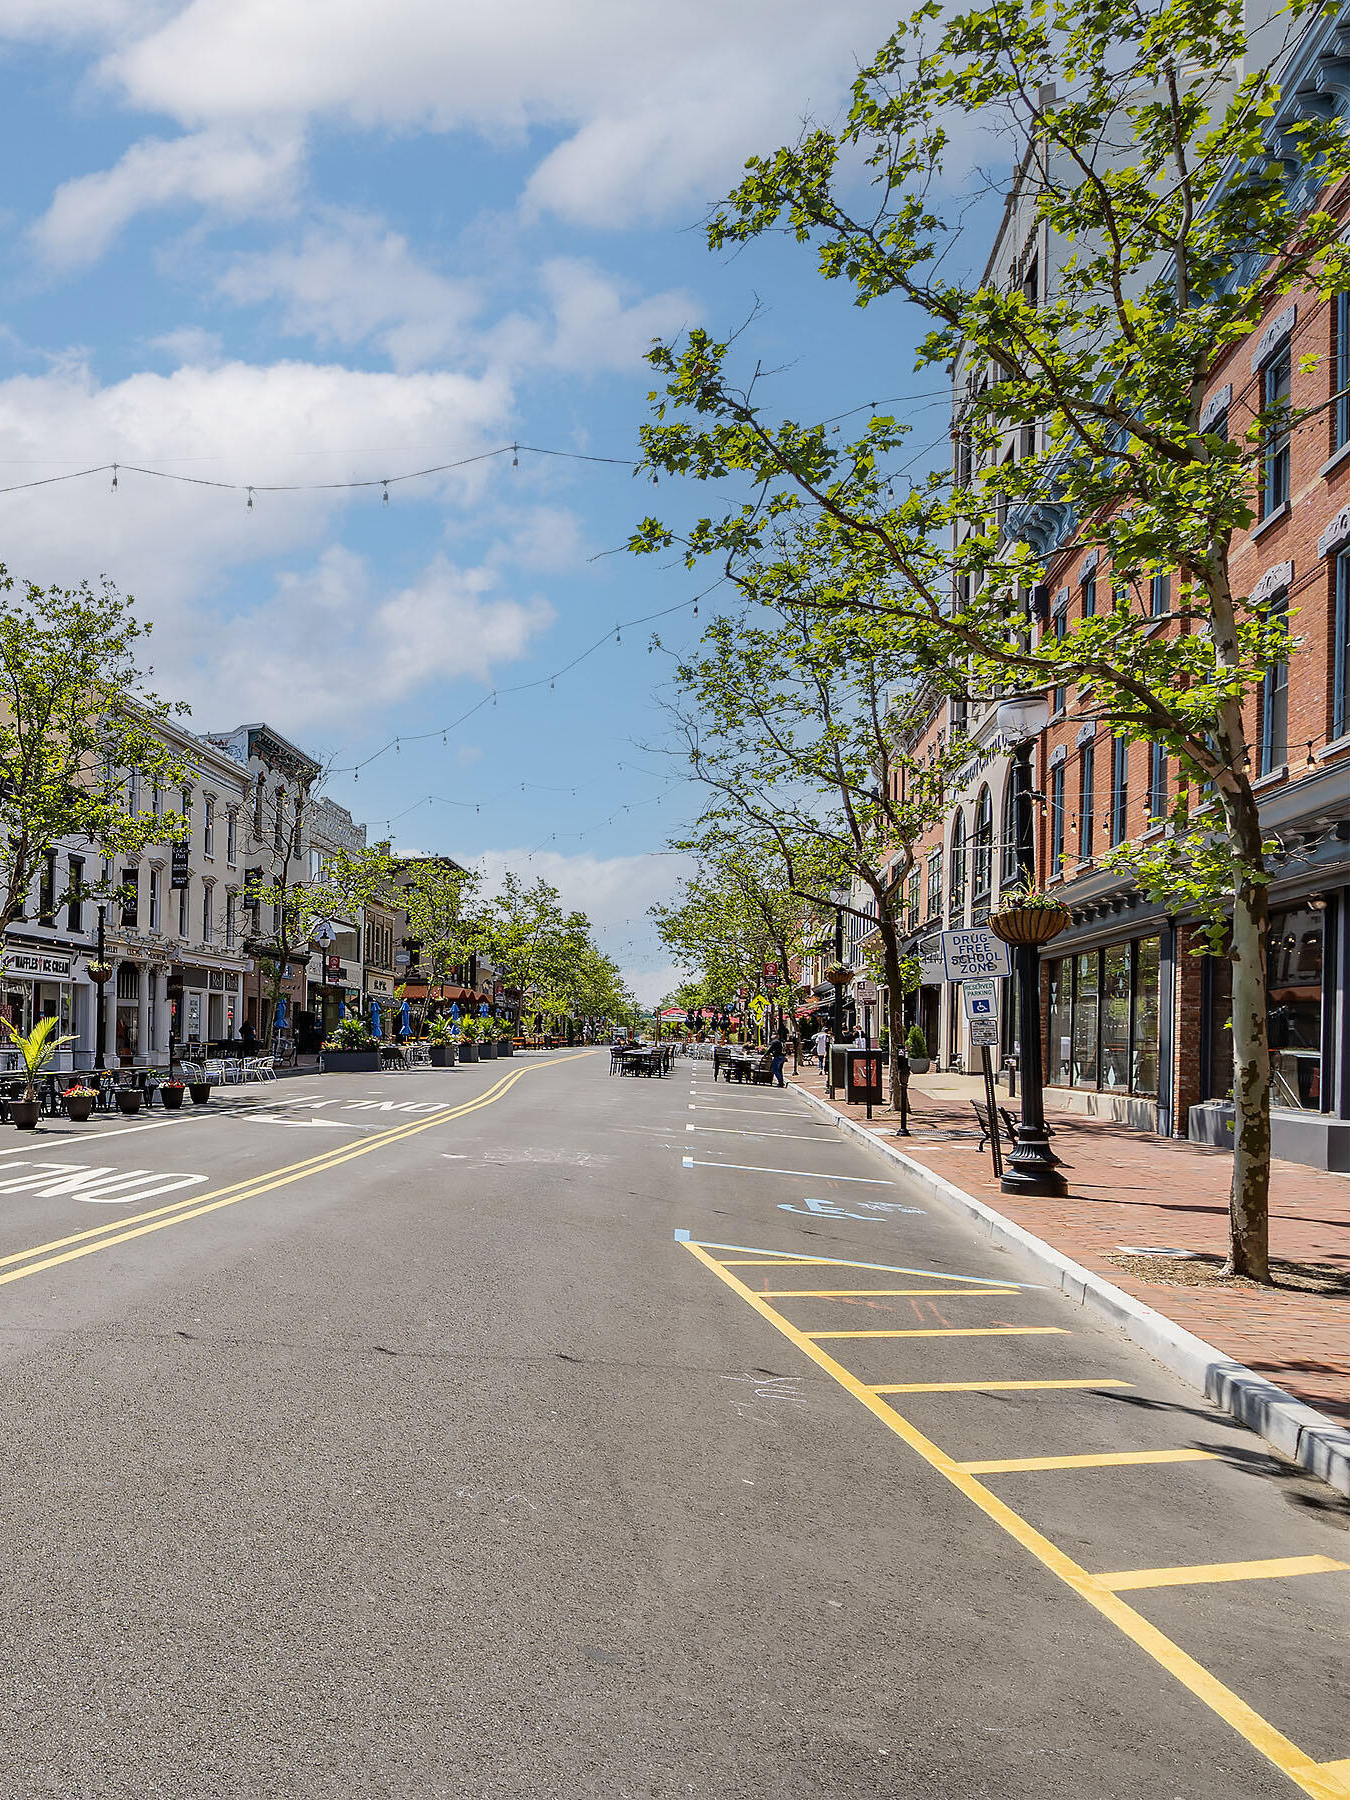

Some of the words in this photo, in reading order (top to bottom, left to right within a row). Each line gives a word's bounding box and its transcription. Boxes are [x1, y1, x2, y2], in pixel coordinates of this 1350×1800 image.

[952, 933, 996, 946] DRUG-
[959, 942, 992, 954] FREE
[951, 951, 1003, 965] SCHOOL
[960, 961, 997, 974] ZONE
[964, 983, 993, 991] RESERVED
[967, 989, 992, 997] PARKING
